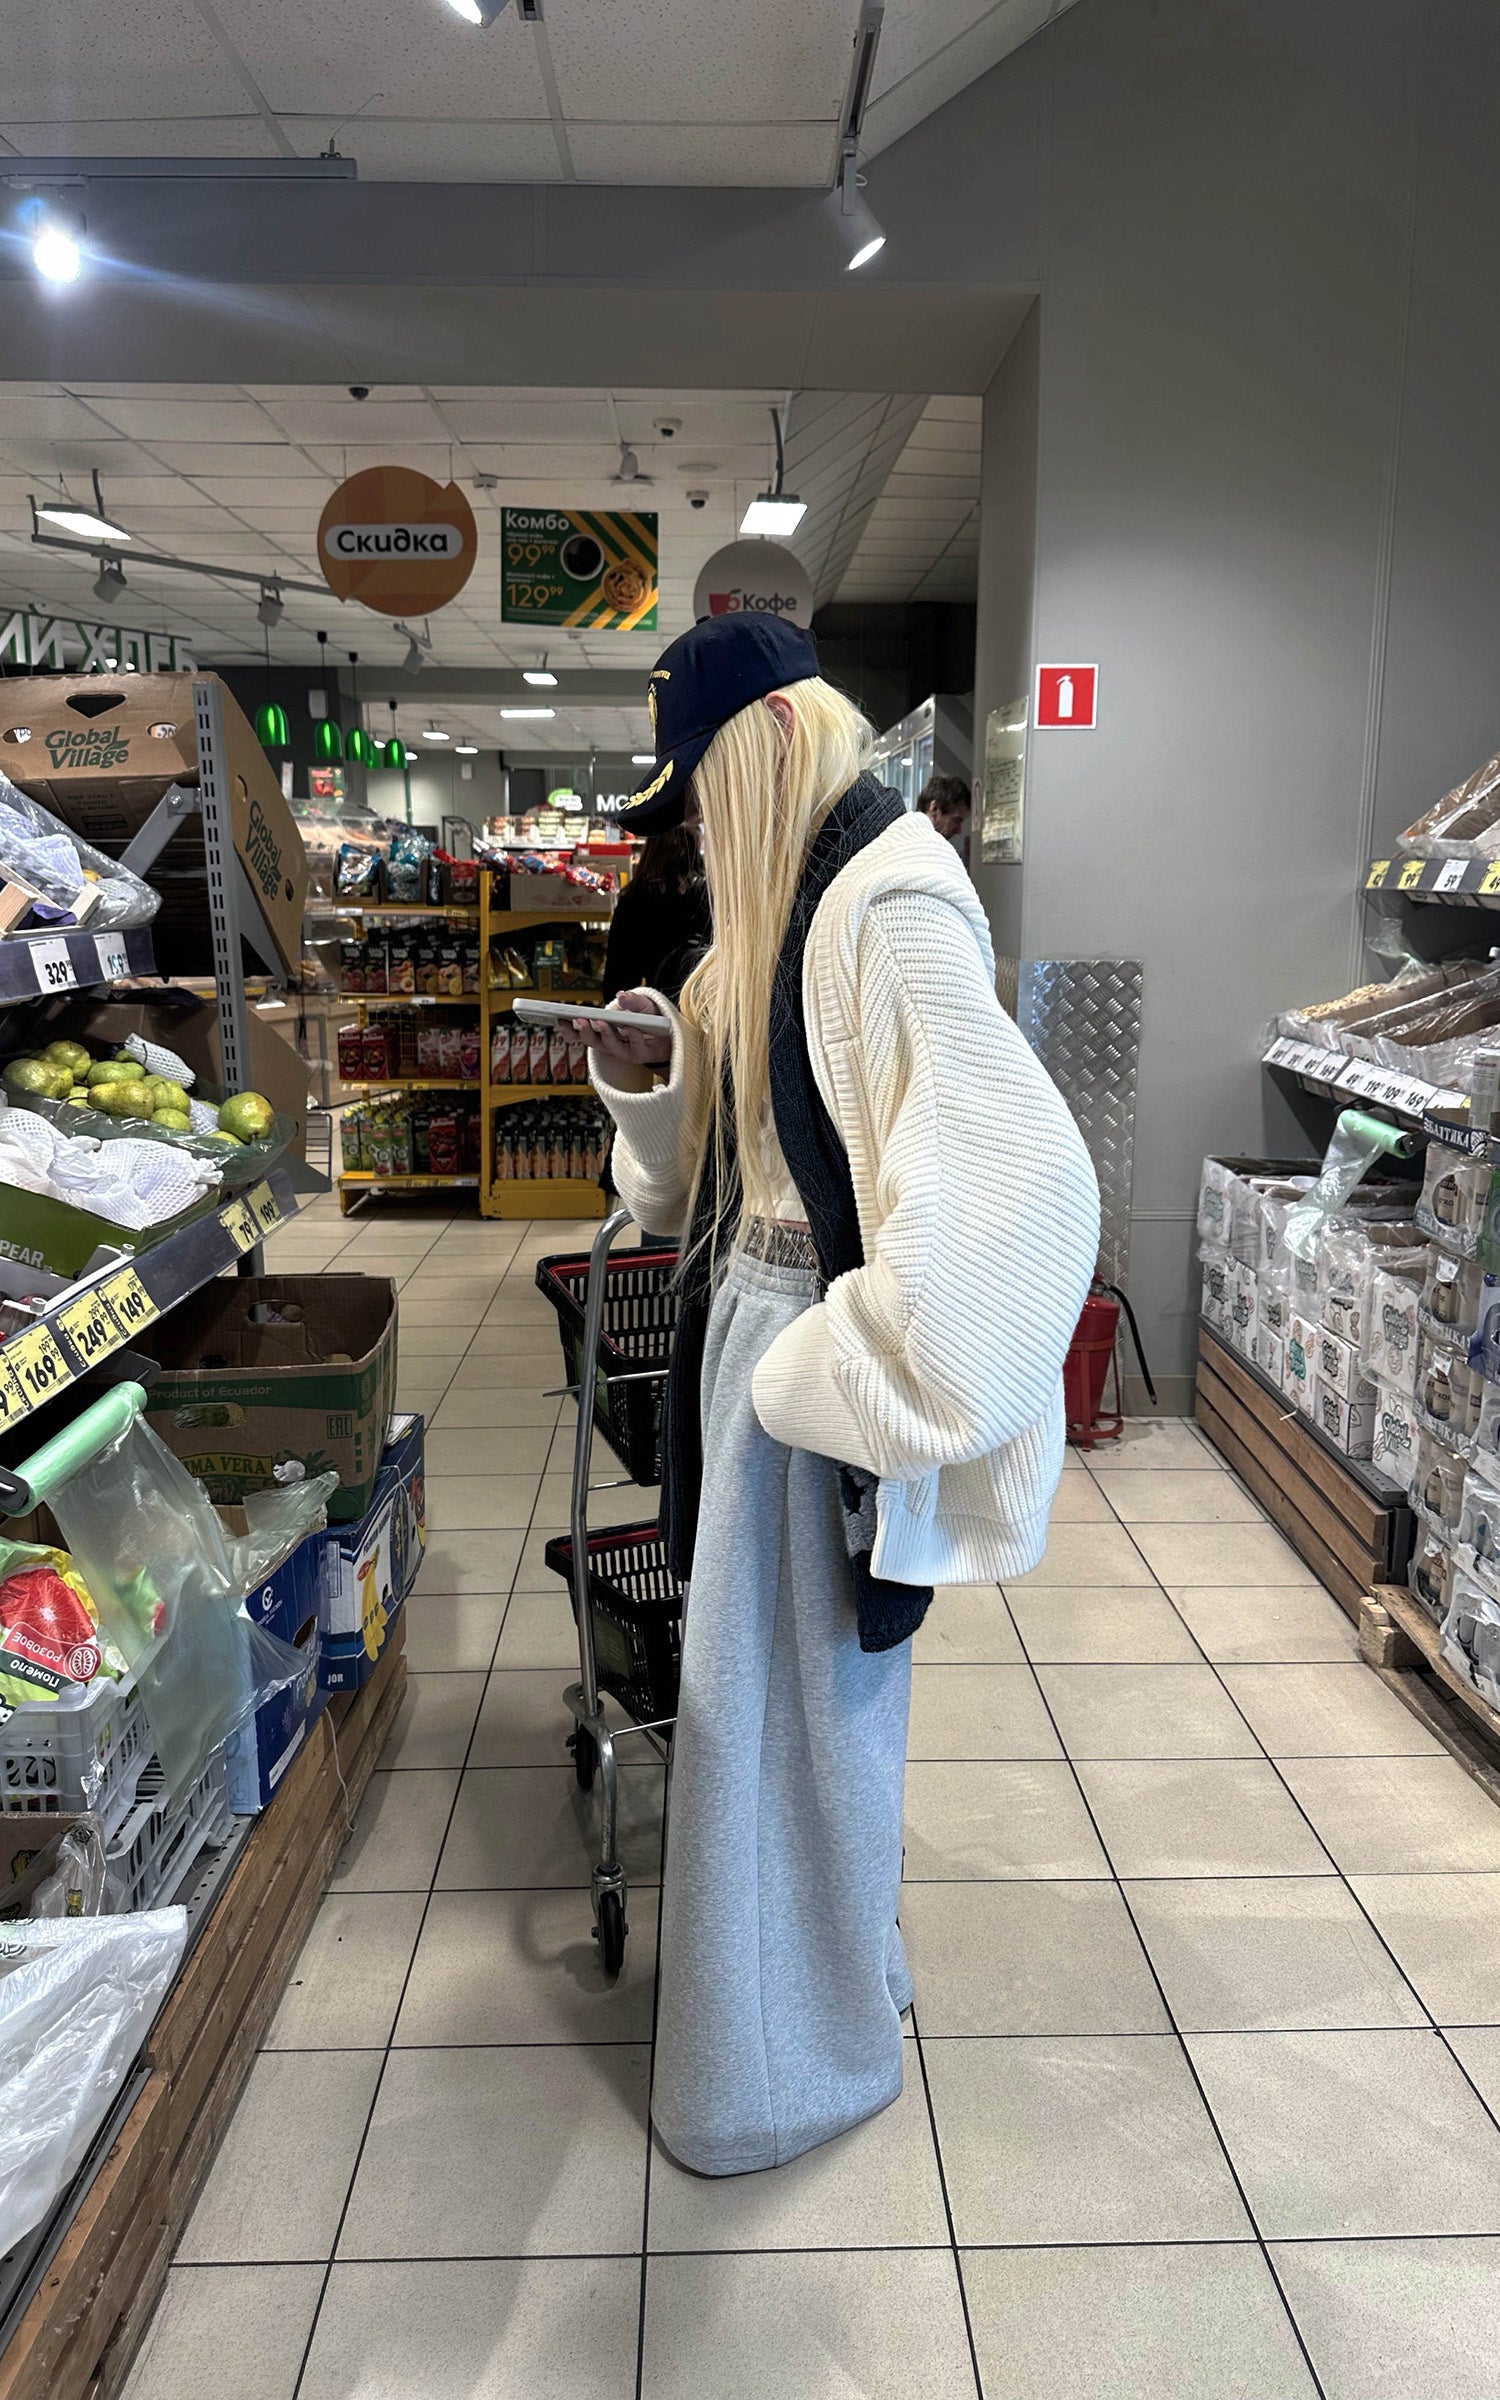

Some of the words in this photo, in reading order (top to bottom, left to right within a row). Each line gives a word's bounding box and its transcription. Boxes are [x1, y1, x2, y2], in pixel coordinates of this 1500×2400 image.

[505, 511, 570, 531] Комбо
[337, 527, 448, 553] Скидка
[508, 543, 542, 566] 99
[507, 584, 550, 608] 129
[743, 593, 798, 615] Кофе
[45, 725, 130, 749] Global
[50, 747, 129, 769] Village
[44, 960, 68, 985] 329
[1363, 1079, 1381, 1094] 119
[1382, 1085, 1402, 1101] 109
[1404, 1091, 1425, 1108] 169
[0, 1239, 45, 1268] PEAR
[119, 1291, 146, 1323] 149
[77, 1318, 108, 1357] 249
[24, 1354, 58, 1394] 169
[148, 1387, 198, 1399] Product
[202, 1386, 216, 1398] of
[218, 1385, 273, 1397] Ecuador
[220, 1456, 266, 1474] VERA
[12, 1631, 63, 1663] РОЗОВОЕ
[10, 1659, 60, 1688] Помело
